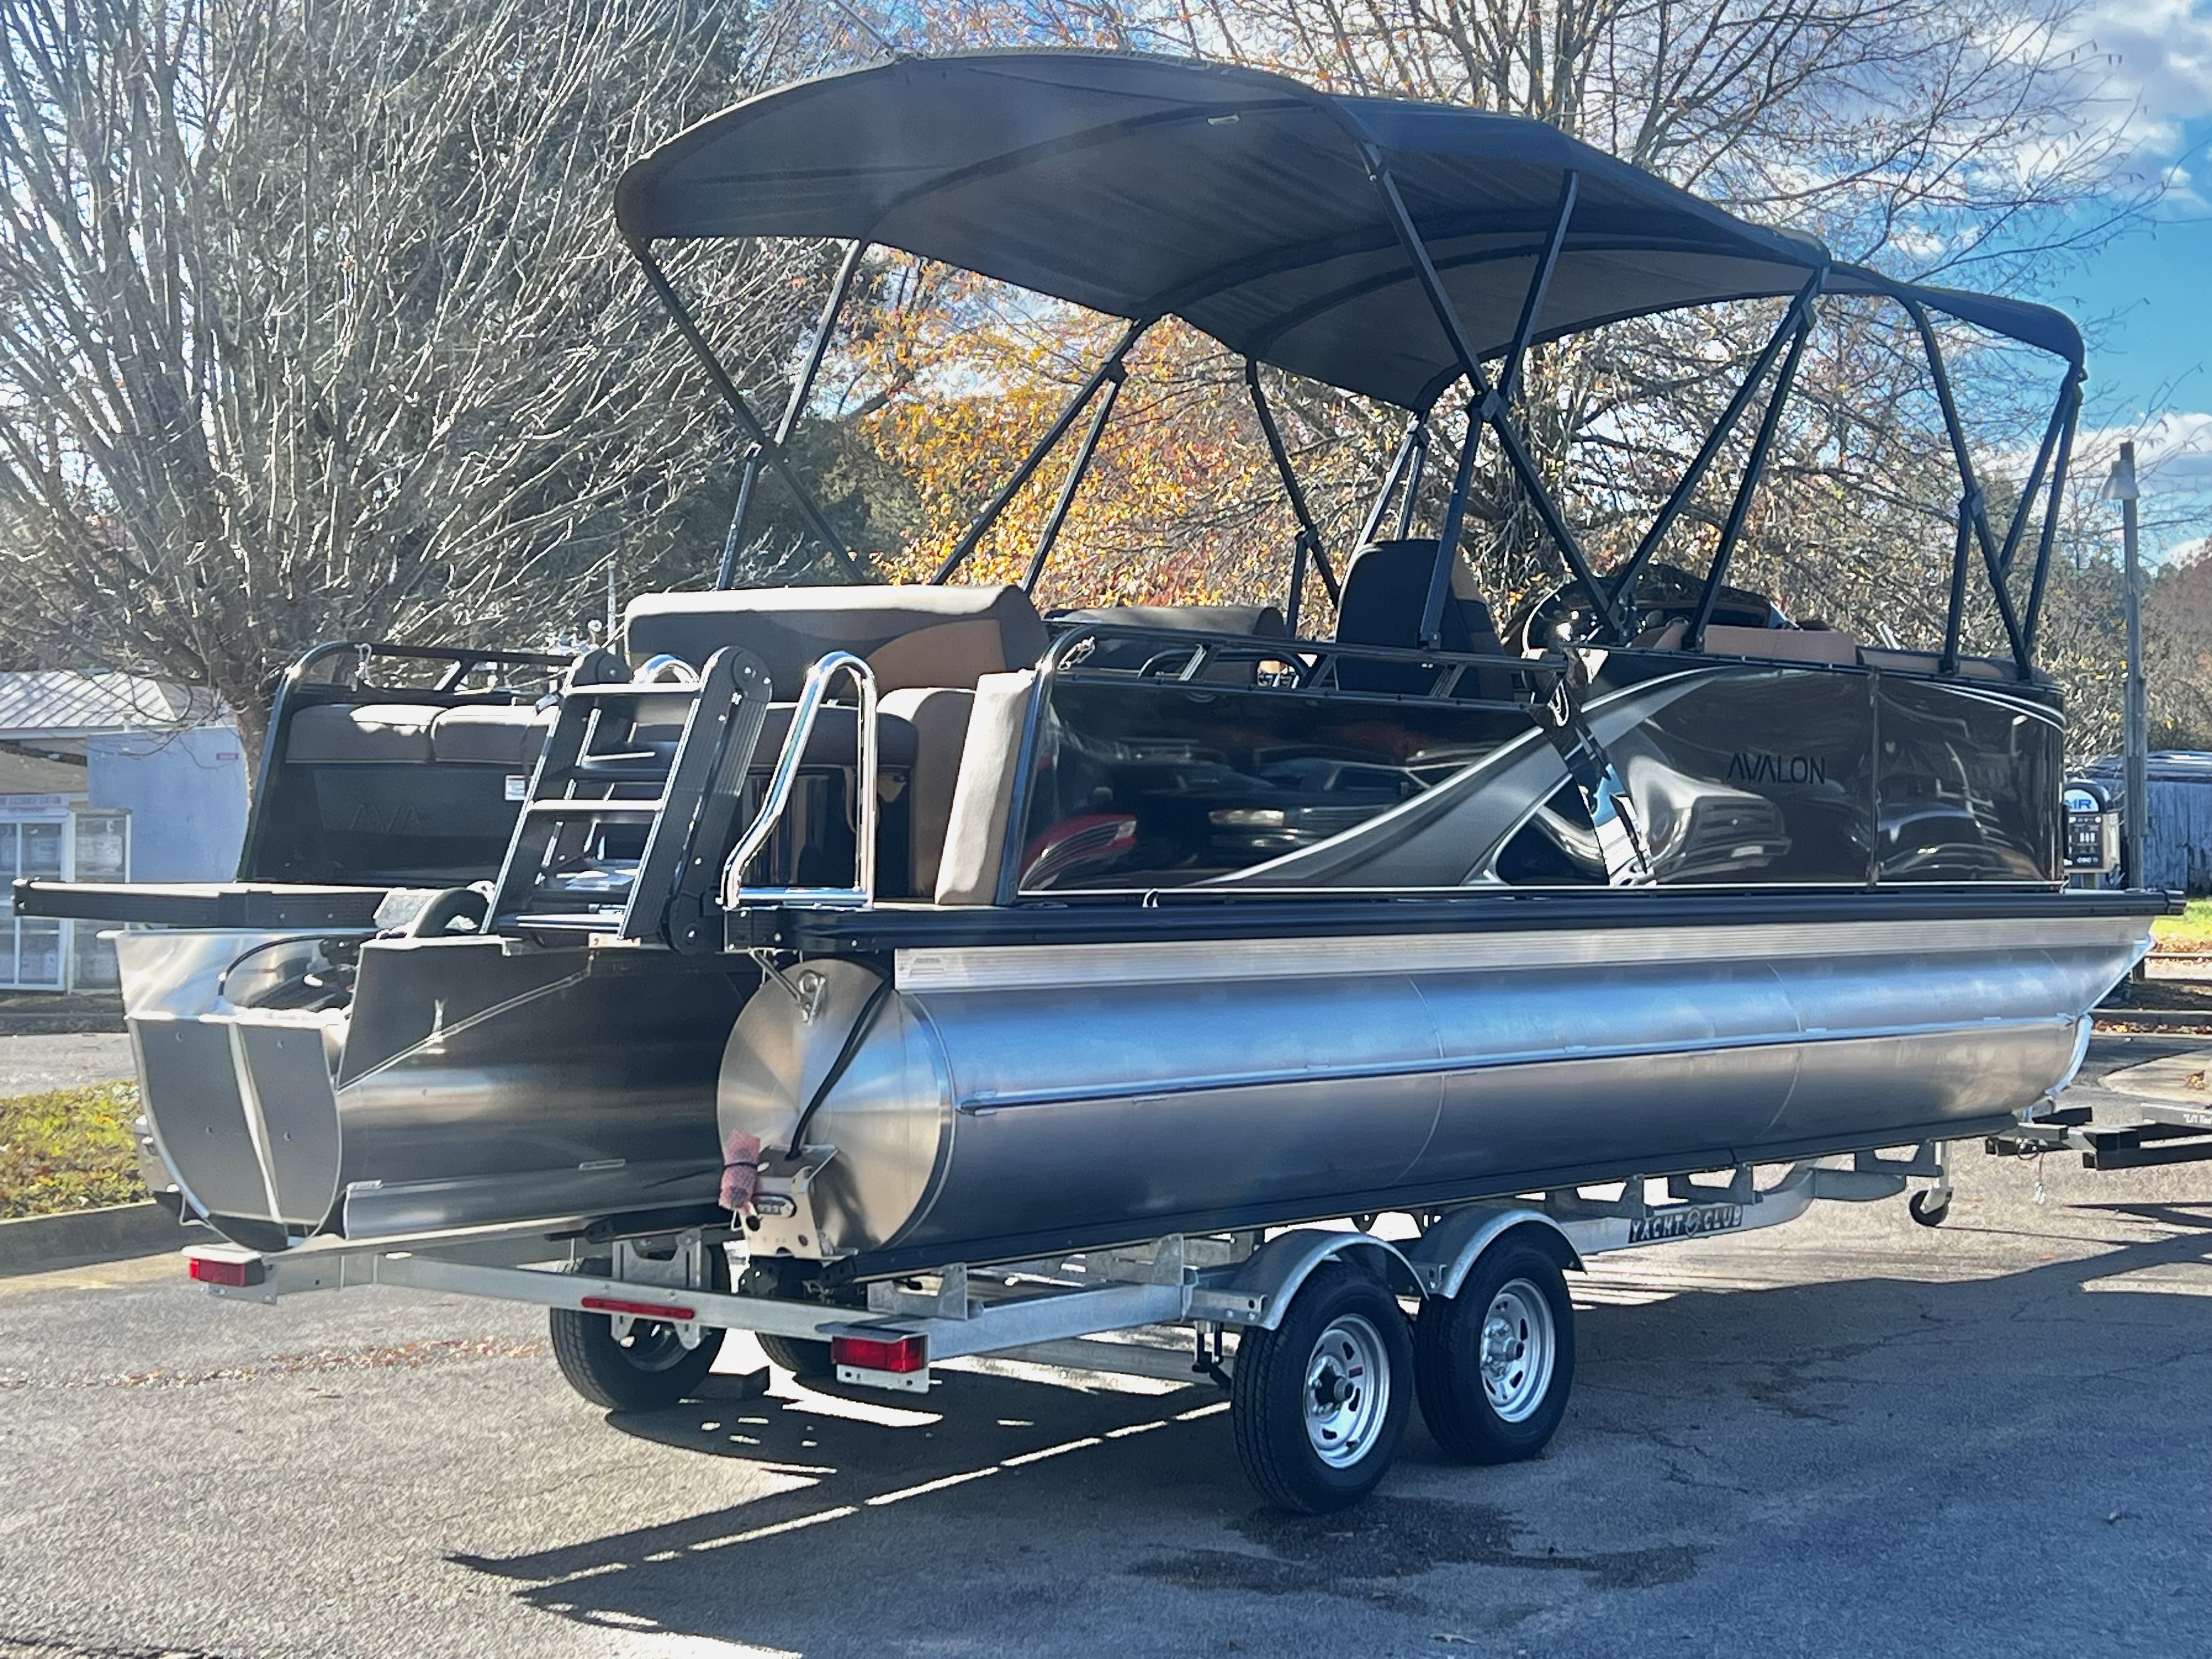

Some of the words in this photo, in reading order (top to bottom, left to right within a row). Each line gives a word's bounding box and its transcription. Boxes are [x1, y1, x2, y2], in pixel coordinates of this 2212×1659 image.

[1726, 752, 1825, 785] AVALON
[1632, 1215, 1684, 1242] YACHT
[1703, 1205, 1741, 1229] CLUB
